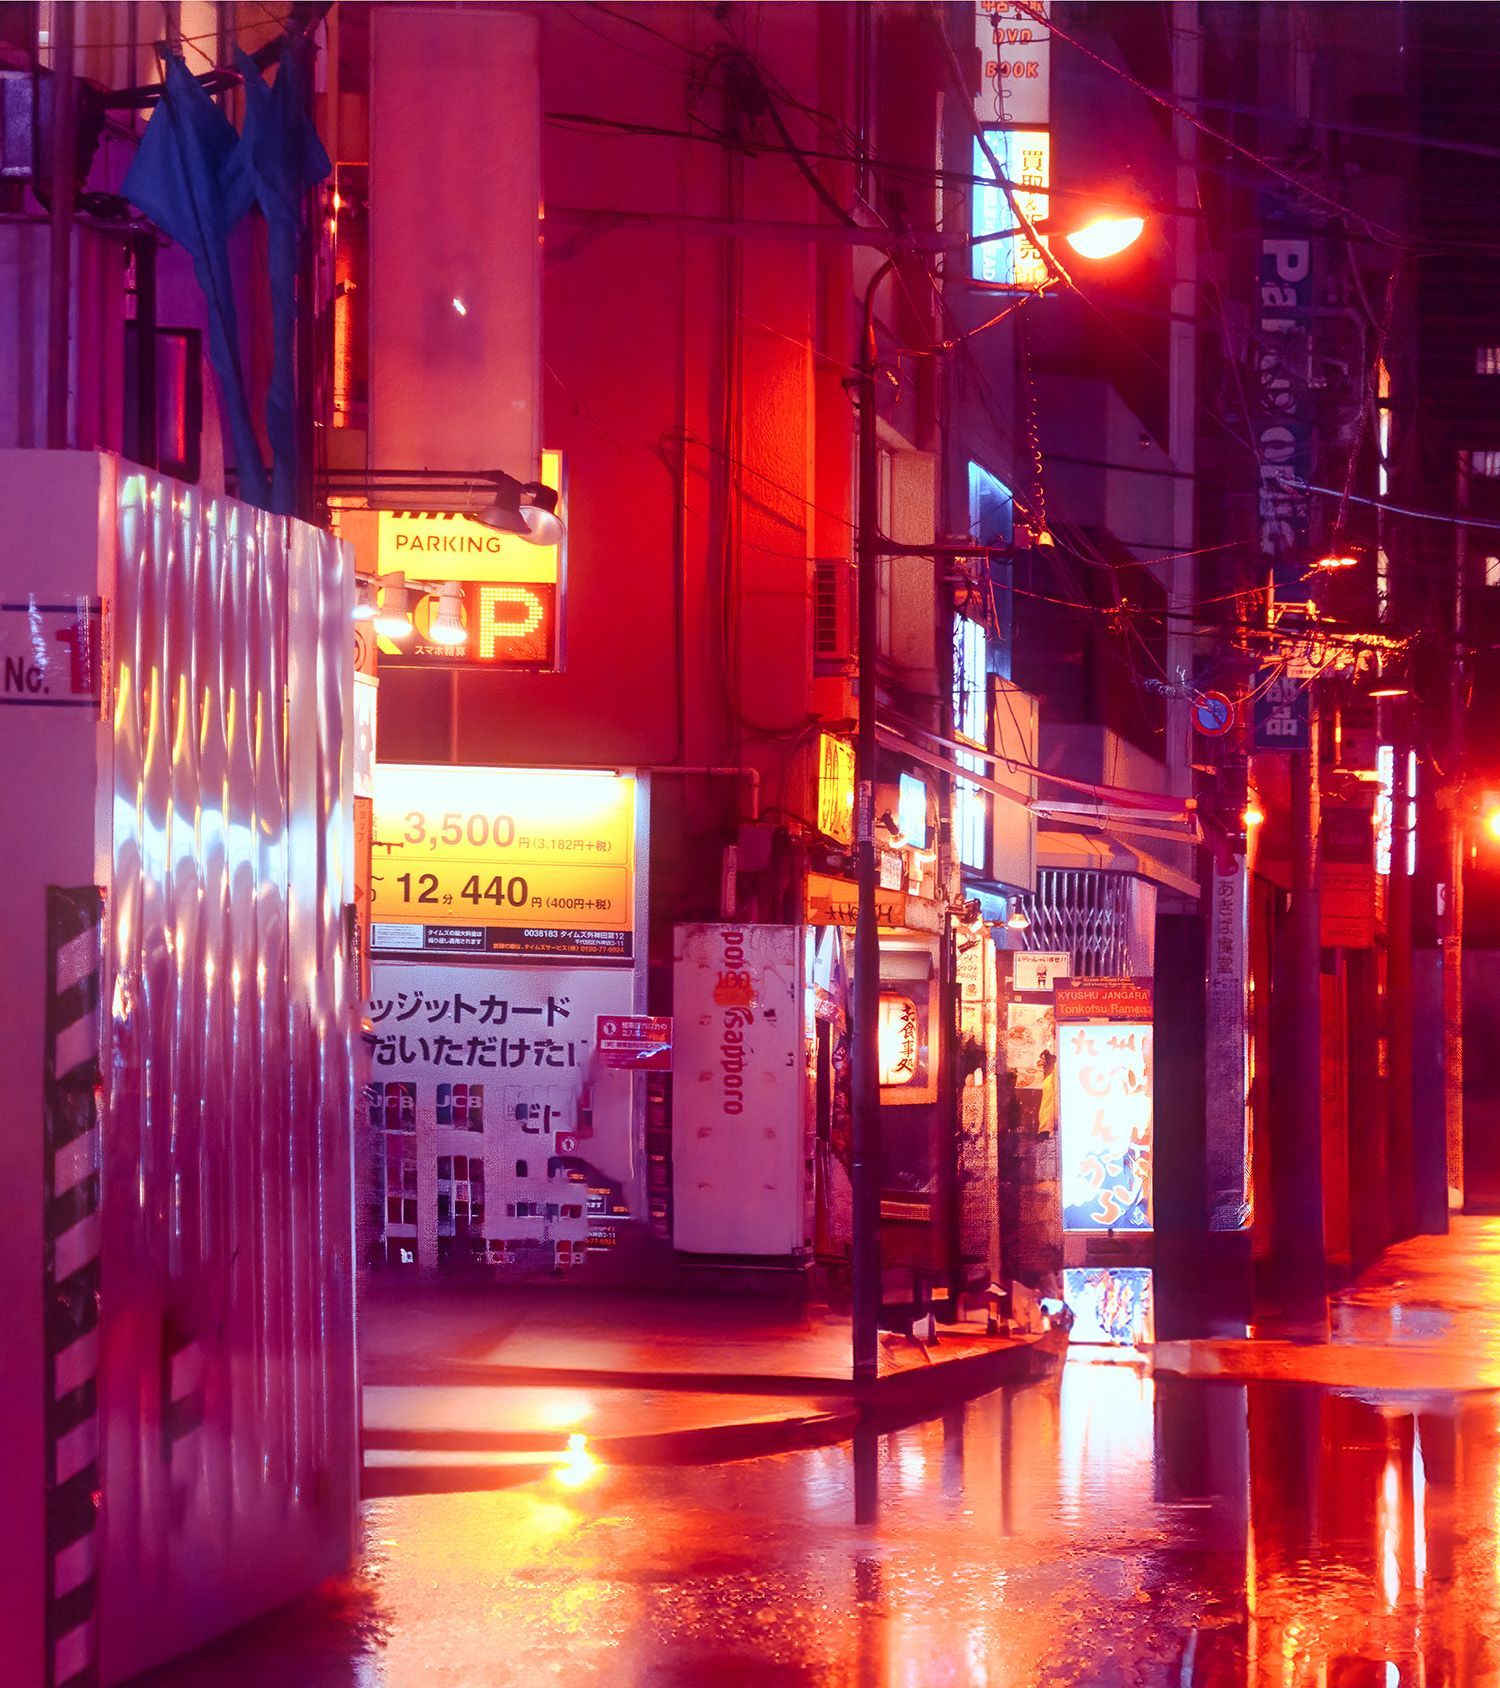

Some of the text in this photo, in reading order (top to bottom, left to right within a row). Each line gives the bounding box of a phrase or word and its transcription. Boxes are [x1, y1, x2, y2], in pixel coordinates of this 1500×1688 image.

[992, 28, 1033, 45] DVD
[985, 60, 1040, 78] BOOK
[396, 534, 501, 553] PARKING
[479, 586, 544, 659] P
[1058, 991, 1148, 1000] KYUSHU JANGARA
[1058, 1003, 1107, 1014] Tonkotsu
[895, 1002, 916, 1073] お食事処
[436, 1095, 483, 1108] JCB
